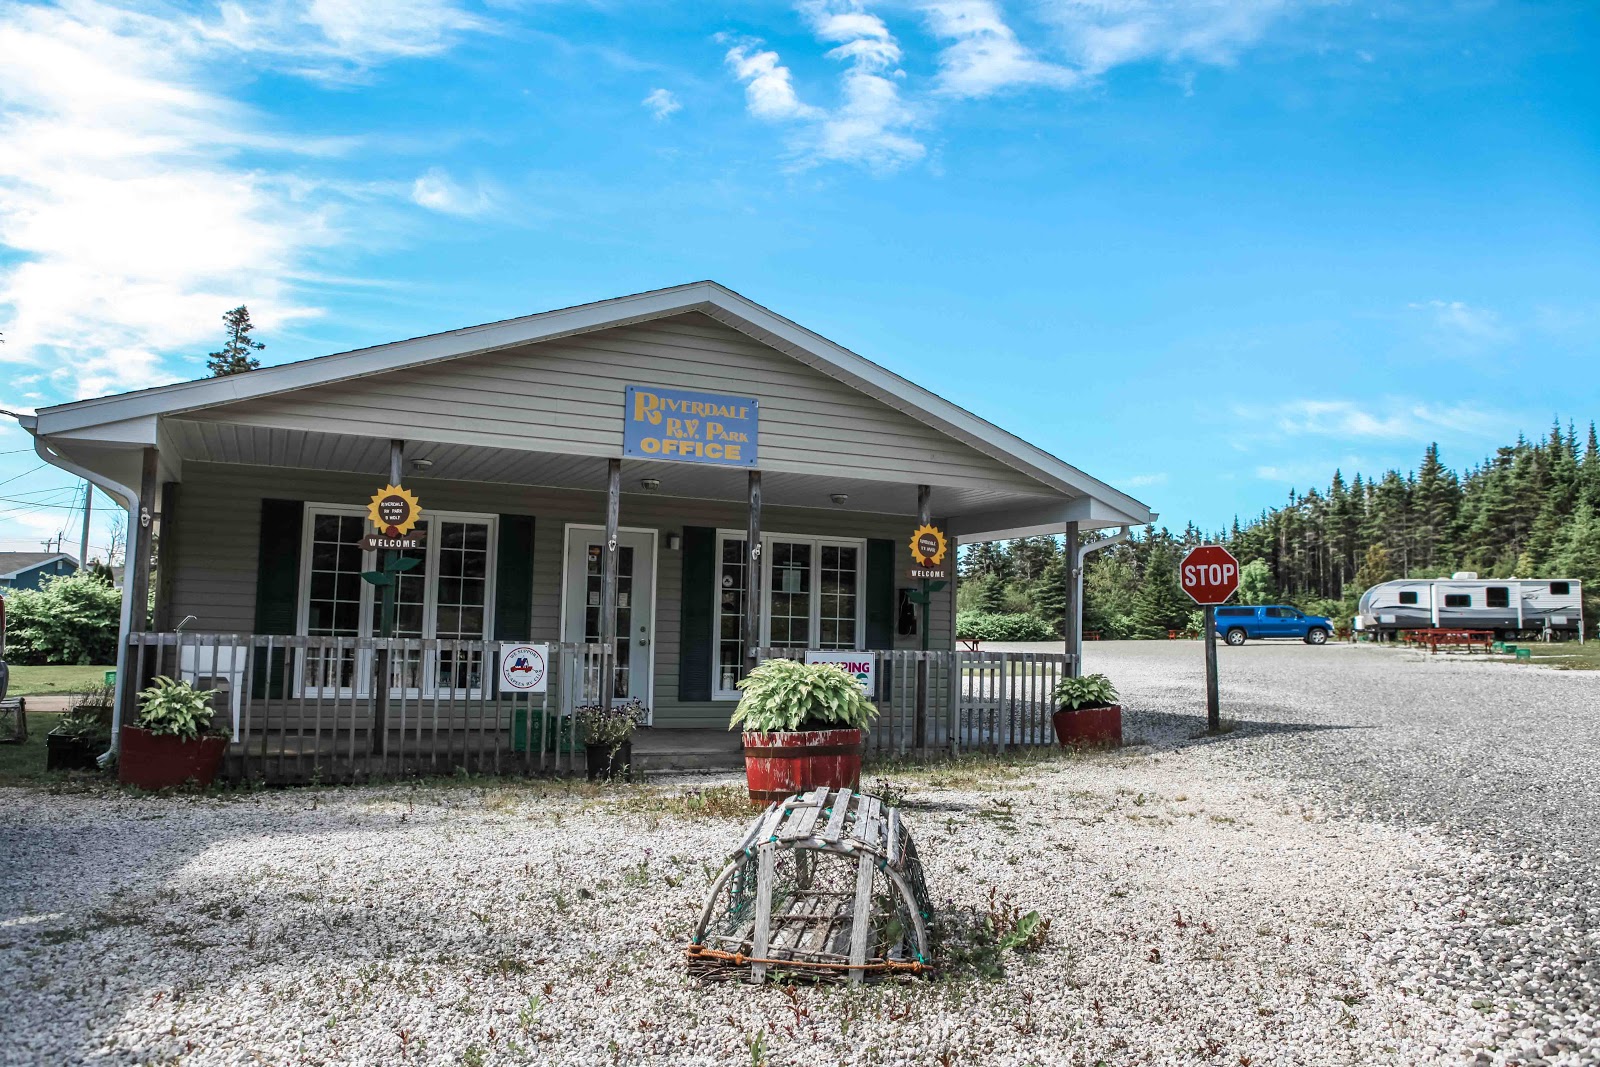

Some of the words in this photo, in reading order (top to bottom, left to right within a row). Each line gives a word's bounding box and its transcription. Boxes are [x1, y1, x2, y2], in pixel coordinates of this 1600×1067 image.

[633, 391, 750, 426] RIVERDALE
[666, 417, 700, 439] R.V.
[706, 421, 749, 443] PARK
[640, 437, 742, 461] OFFICE
[368, 538, 417, 548] WELCOME
[911, 569, 945, 578] WELCOME
[1184, 563, 1235, 587] STOP
[517, 649, 539, 659] SUPPORT
